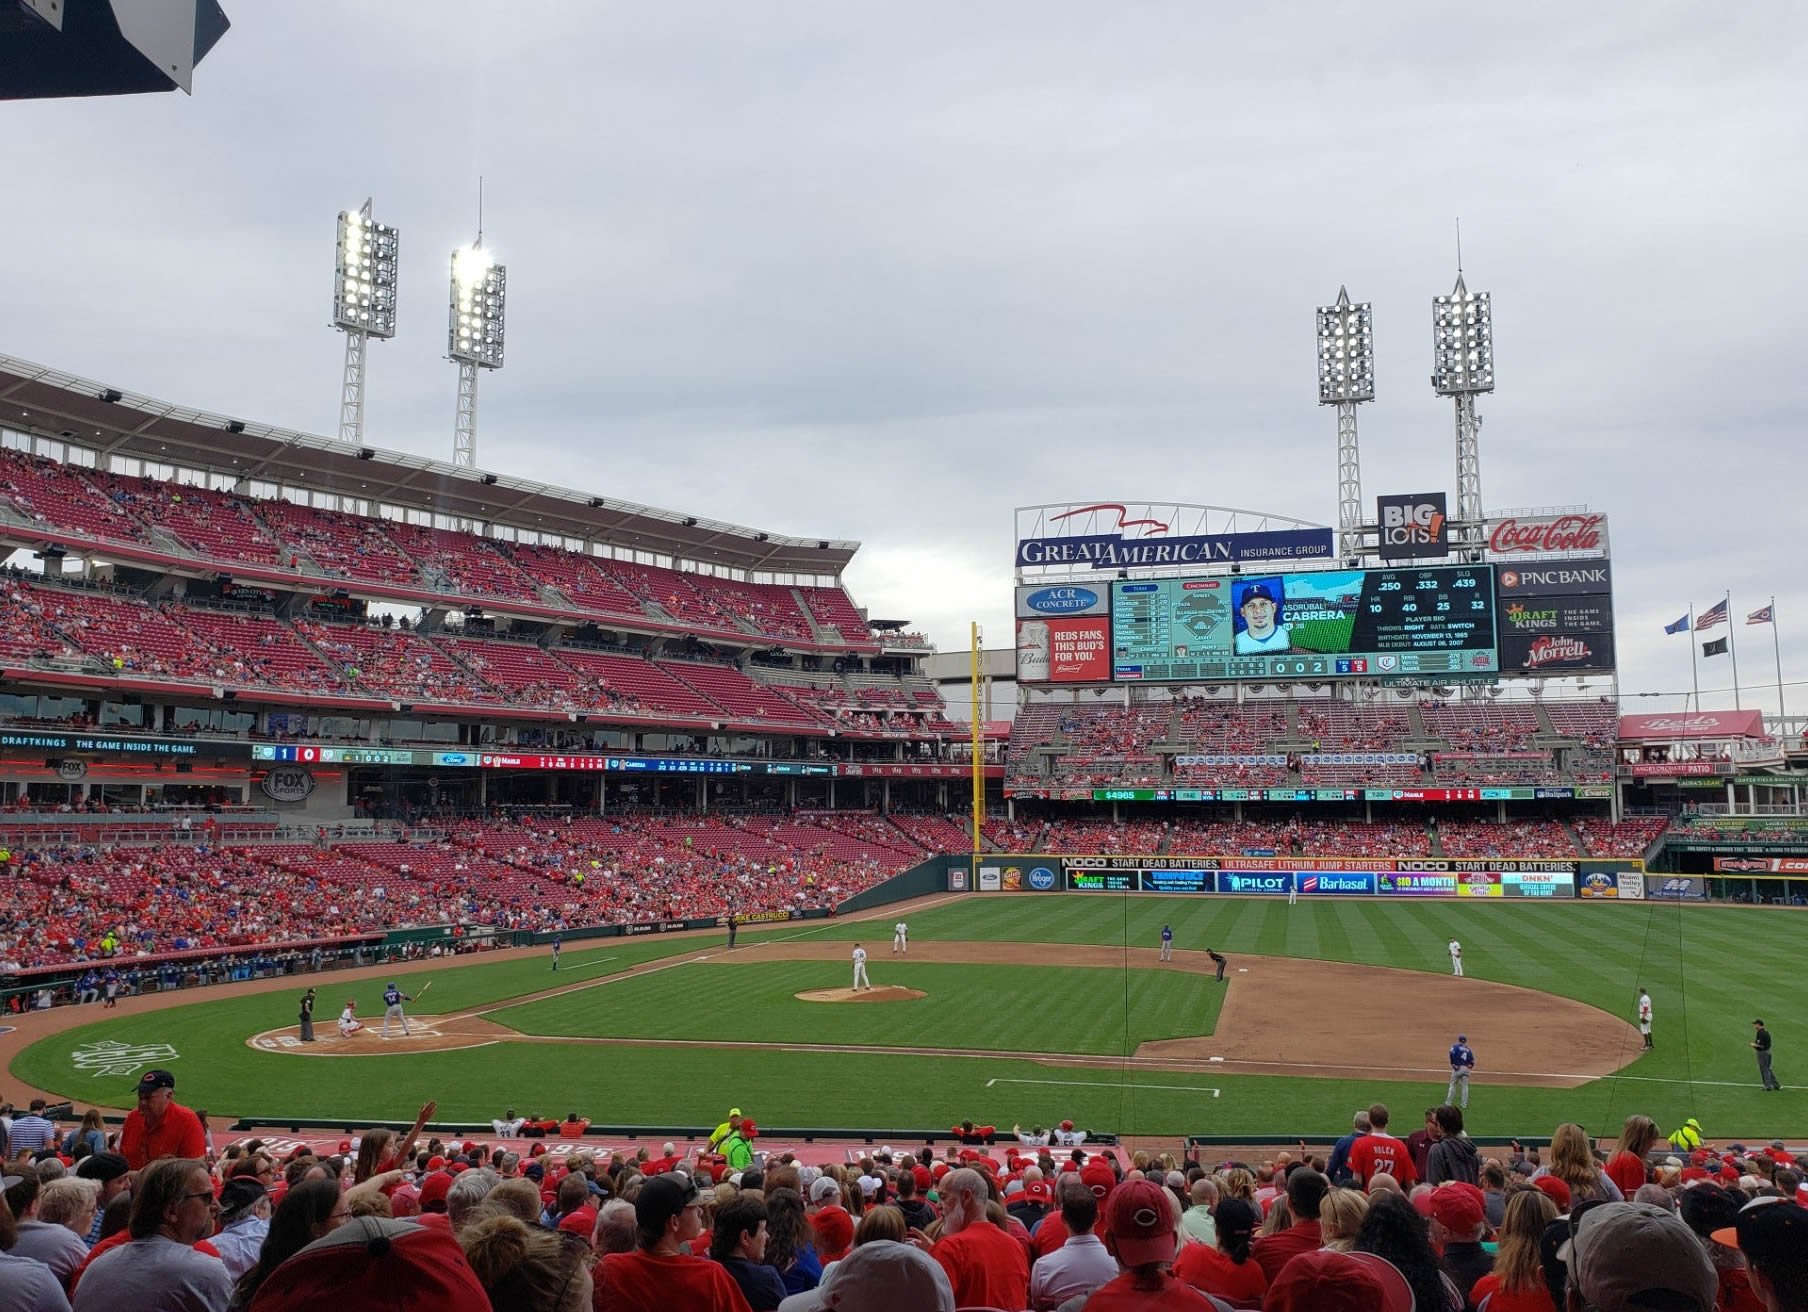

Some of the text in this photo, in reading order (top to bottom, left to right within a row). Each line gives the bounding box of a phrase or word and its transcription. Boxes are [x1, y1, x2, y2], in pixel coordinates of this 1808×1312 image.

[1384, 504, 1438, 528] BIG
[1022, 541, 1233, 564] GREAT AMERICAN
[1240, 545, 1327, 558] INSURANCE GROUP
[1520, 569, 1606, 585] PNC BANK
[1378, 579, 1476, 591] .250 .332 .439
[1048, 589, 1076, 600] ACR
[1036, 599, 1087, 609] CONCRETE
[1370, 601, 1484, 612] 10 40 25 32
[1282, 610, 1345, 621] CABRERA
[1509, 610, 1558, 622] DRAFT
[1516, 620, 1557, 628] KINGS
[1054, 630, 1104, 641] REDS FANS,
[1055, 641, 1104, 651] THIS BUD'S
[1548, 636, 1574, 648] John
[1055, 652, 1095, 662] FOR YOU.
[1522, 642, 1592, 667] Morrell
[1276, 662, 1322, 672] 0 0 2
[1450, 678, 1494, 686] SHUTTLE
[1643, 716, 1719, 728] Reds
[2, 736, 197, 754] DRAFTKINGS THE GAME INSIDE THE GAME.
[282, 748, 287, 758] 1
[304, 748, 314, 760] 0
[62, 762, 81, 771] FOX
[1688, 764, 1710, 772] PATIO
[274, 773, 304, 788] FOX
[1062, 858, 1574, 872] NOCO START DEAD BATTERIES. ULTRASAFE LITHIUM JUMP STARTERS. NOCO START DEAD BATTERIES.
[1032, 871, 1052, 886] Kroger
[1075, 876, 1104, 884] DRAFT
[1241, 878, 1284, 888] PILOT
[1320, 876, 1368, 890] Barbasol
[1397, 877, 1455, 886] $10 A MONTH
[752, 912, 789, 920] CASTRUCCI
[1460, 1052, 1467, 1060] 4
[1374, 1158, 1394, 1174] 27
